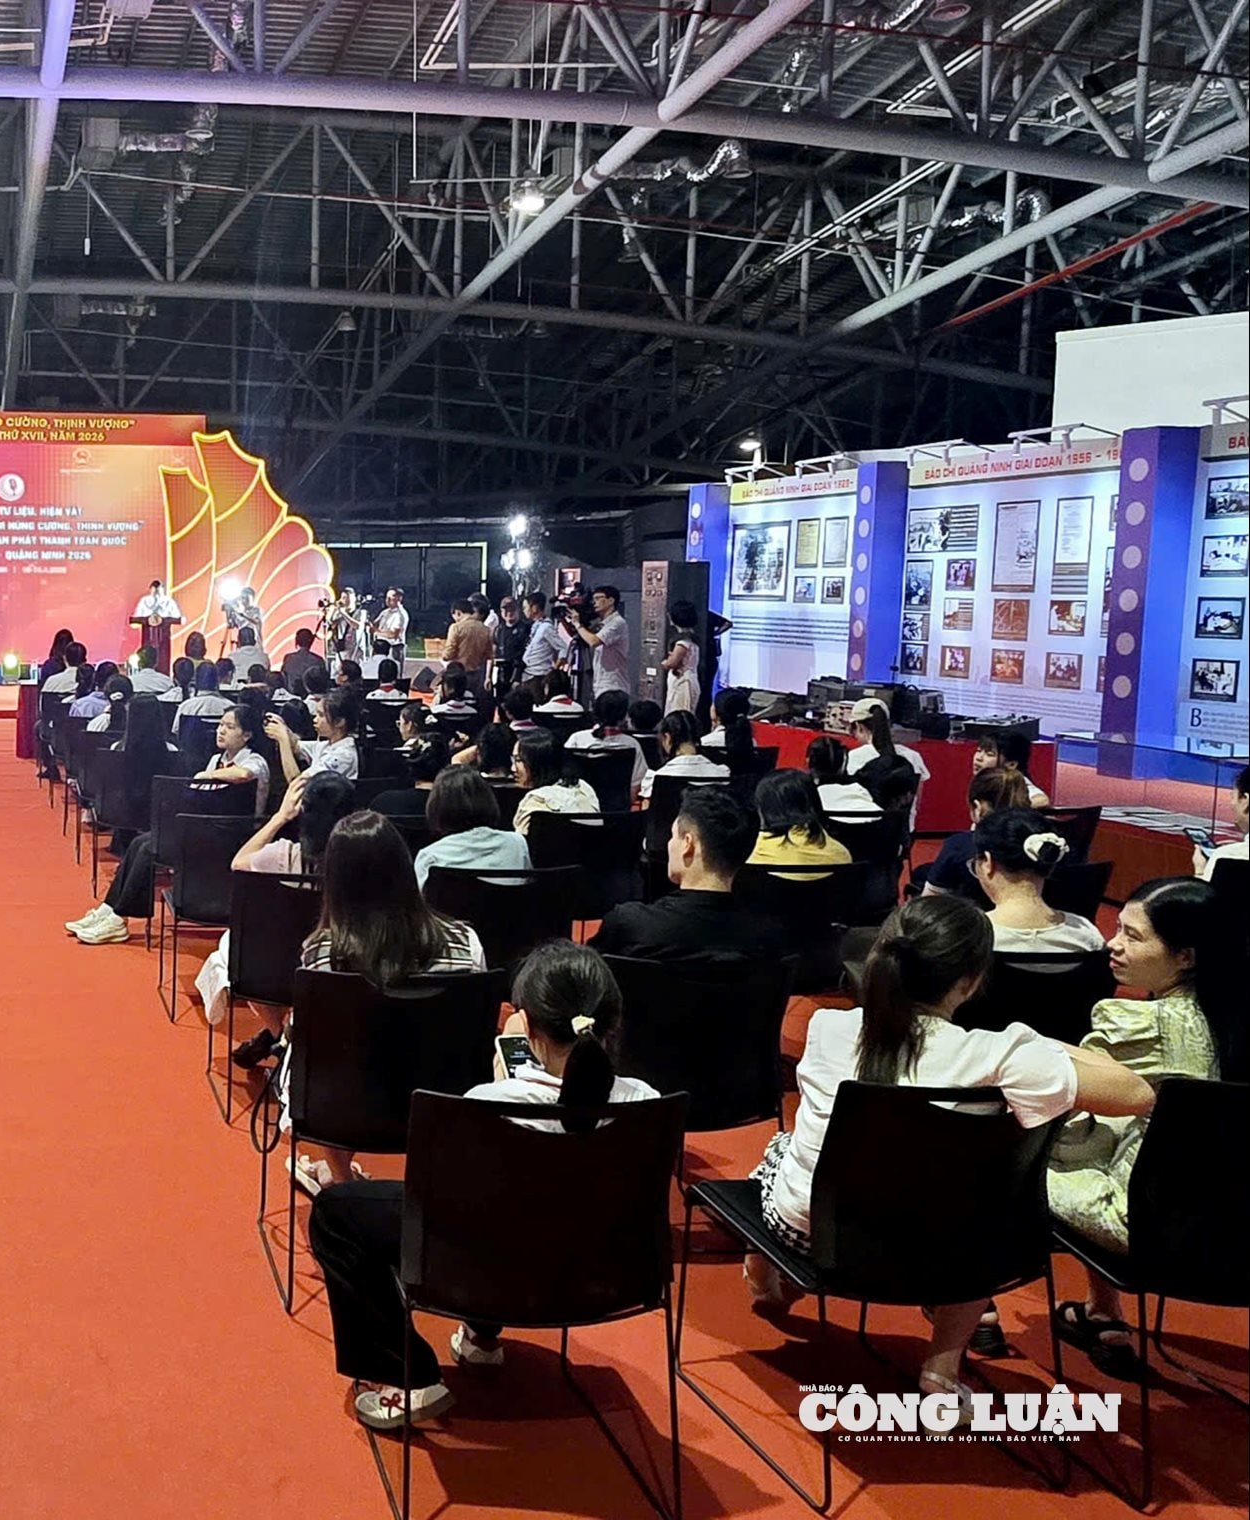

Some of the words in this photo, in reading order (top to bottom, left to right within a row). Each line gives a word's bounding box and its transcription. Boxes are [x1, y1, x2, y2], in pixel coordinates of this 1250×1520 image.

[21, 431, 47, 442] XVII,
[78, 432, 105, 442] 2026
[1228, 432, 1249, 449] BÁ
